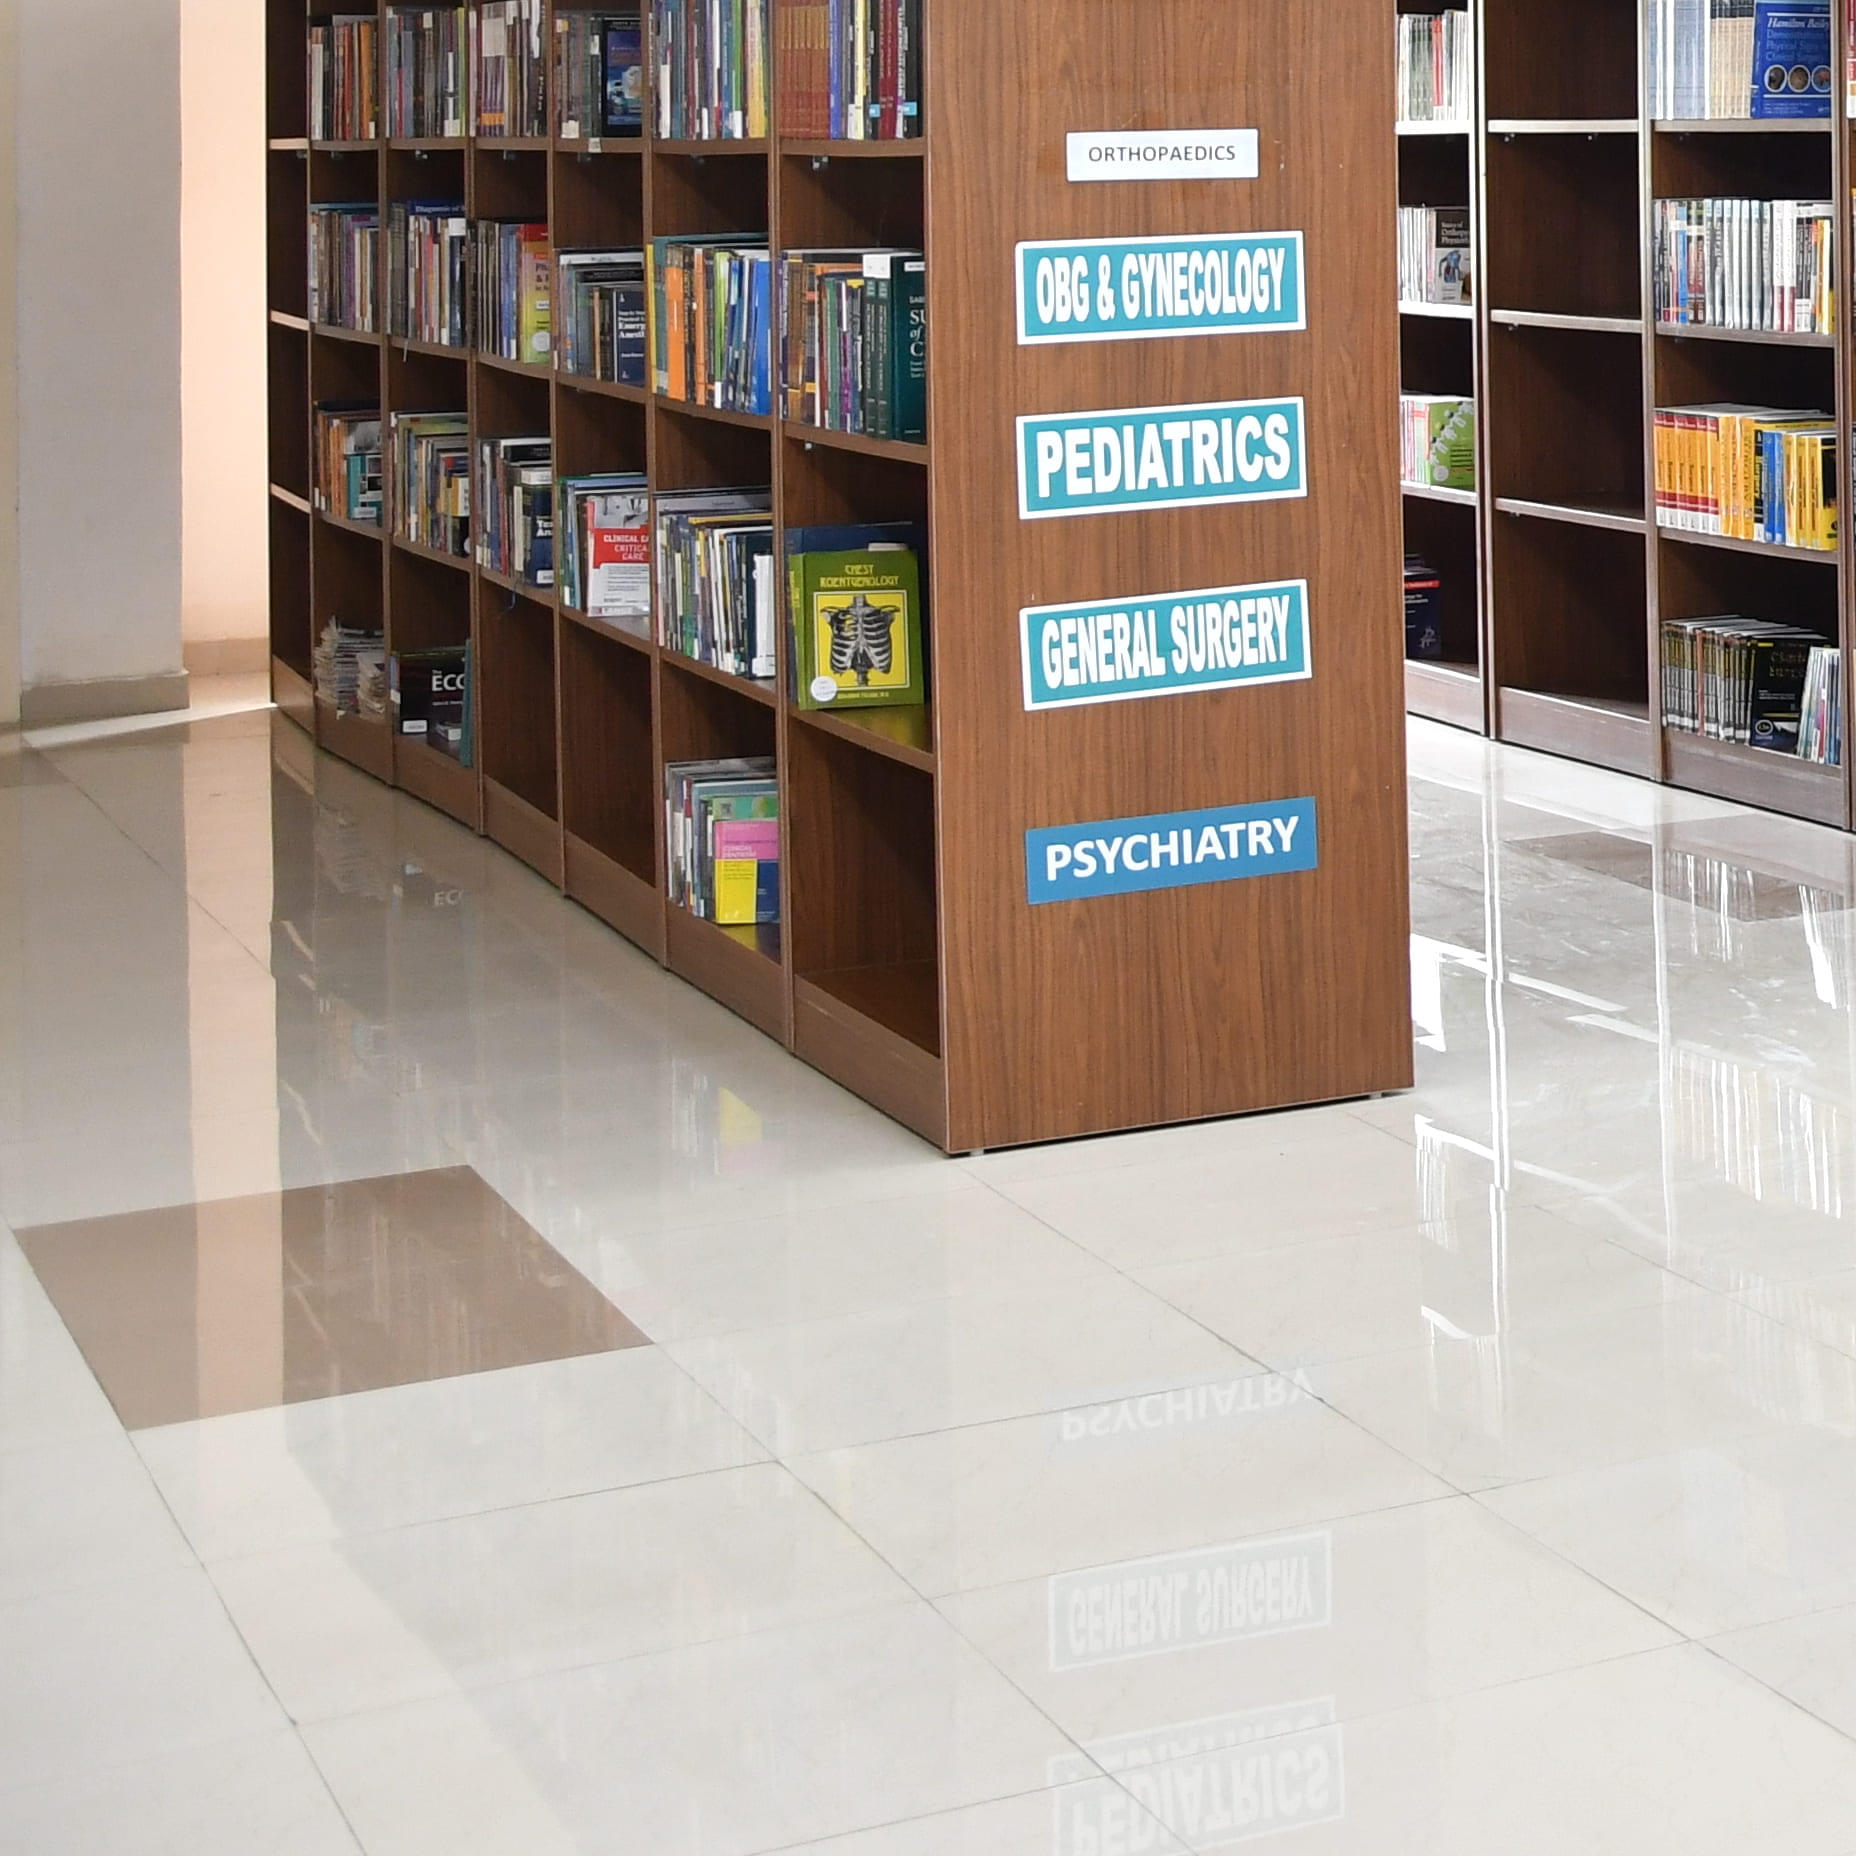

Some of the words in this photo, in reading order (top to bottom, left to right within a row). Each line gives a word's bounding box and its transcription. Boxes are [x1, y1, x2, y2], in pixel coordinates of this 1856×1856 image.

[1088, 145, 1236, 162] ORTHOPAEDICS
[1036, 255, 1090, 324] OBG
[1097, 254, 1116, 321] &
[1121, 247, 1285, 320] GYNECOLOGY
[1036, 413, 1291, 498] PEDIATRICS
[1041, 609, 1167, 689] GENERAL
[1170, 594, 1290, 674] SURGERY
[1046, 815, 1300, 882] PSYCHIATRY
